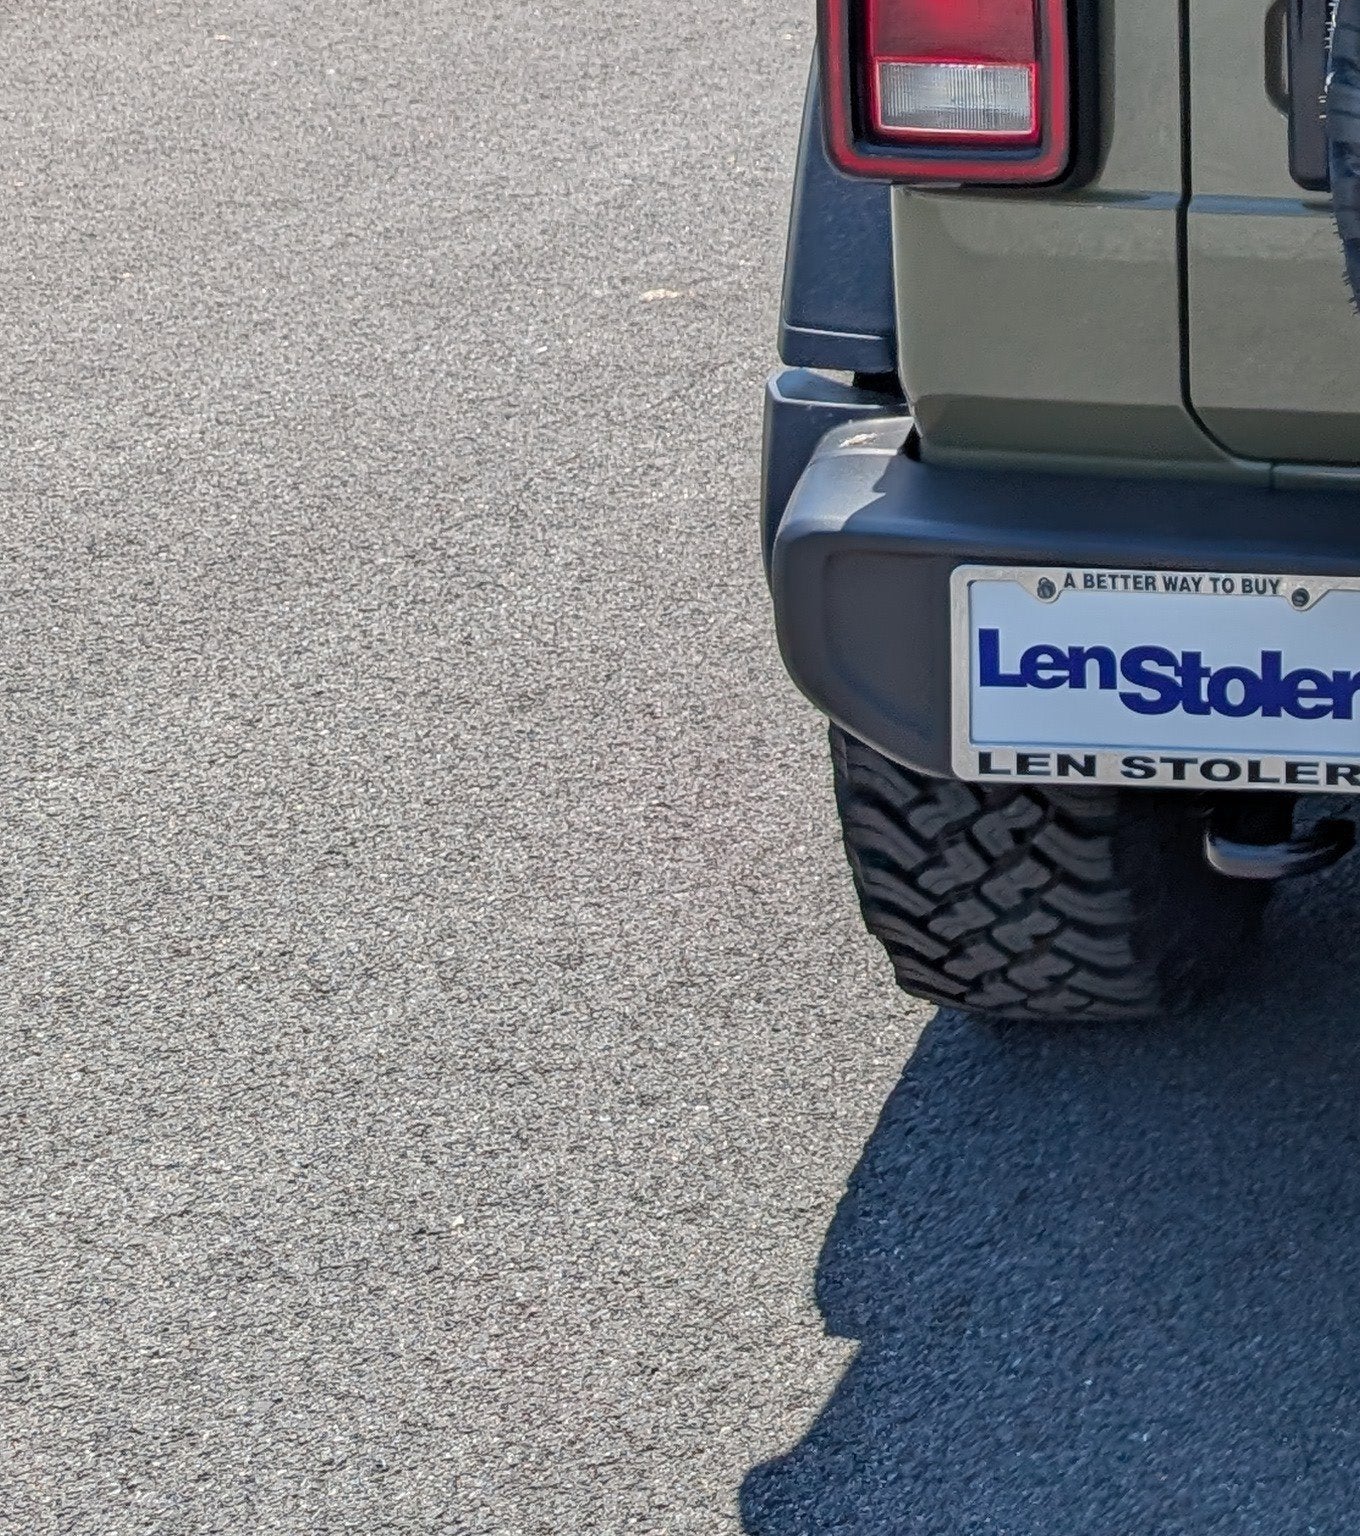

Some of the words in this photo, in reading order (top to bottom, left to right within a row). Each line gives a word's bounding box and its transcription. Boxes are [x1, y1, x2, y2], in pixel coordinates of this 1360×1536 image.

[1063, 572, 1077, 589] A
[1083, 573, 1157, 592] BETTER
[1162, 575, 1204, 593] WAY
[1209, 577, 1235, 595] TO
[1241, 578, 1281, 596] BUY
[978, 751, 1097, 778] LEN
